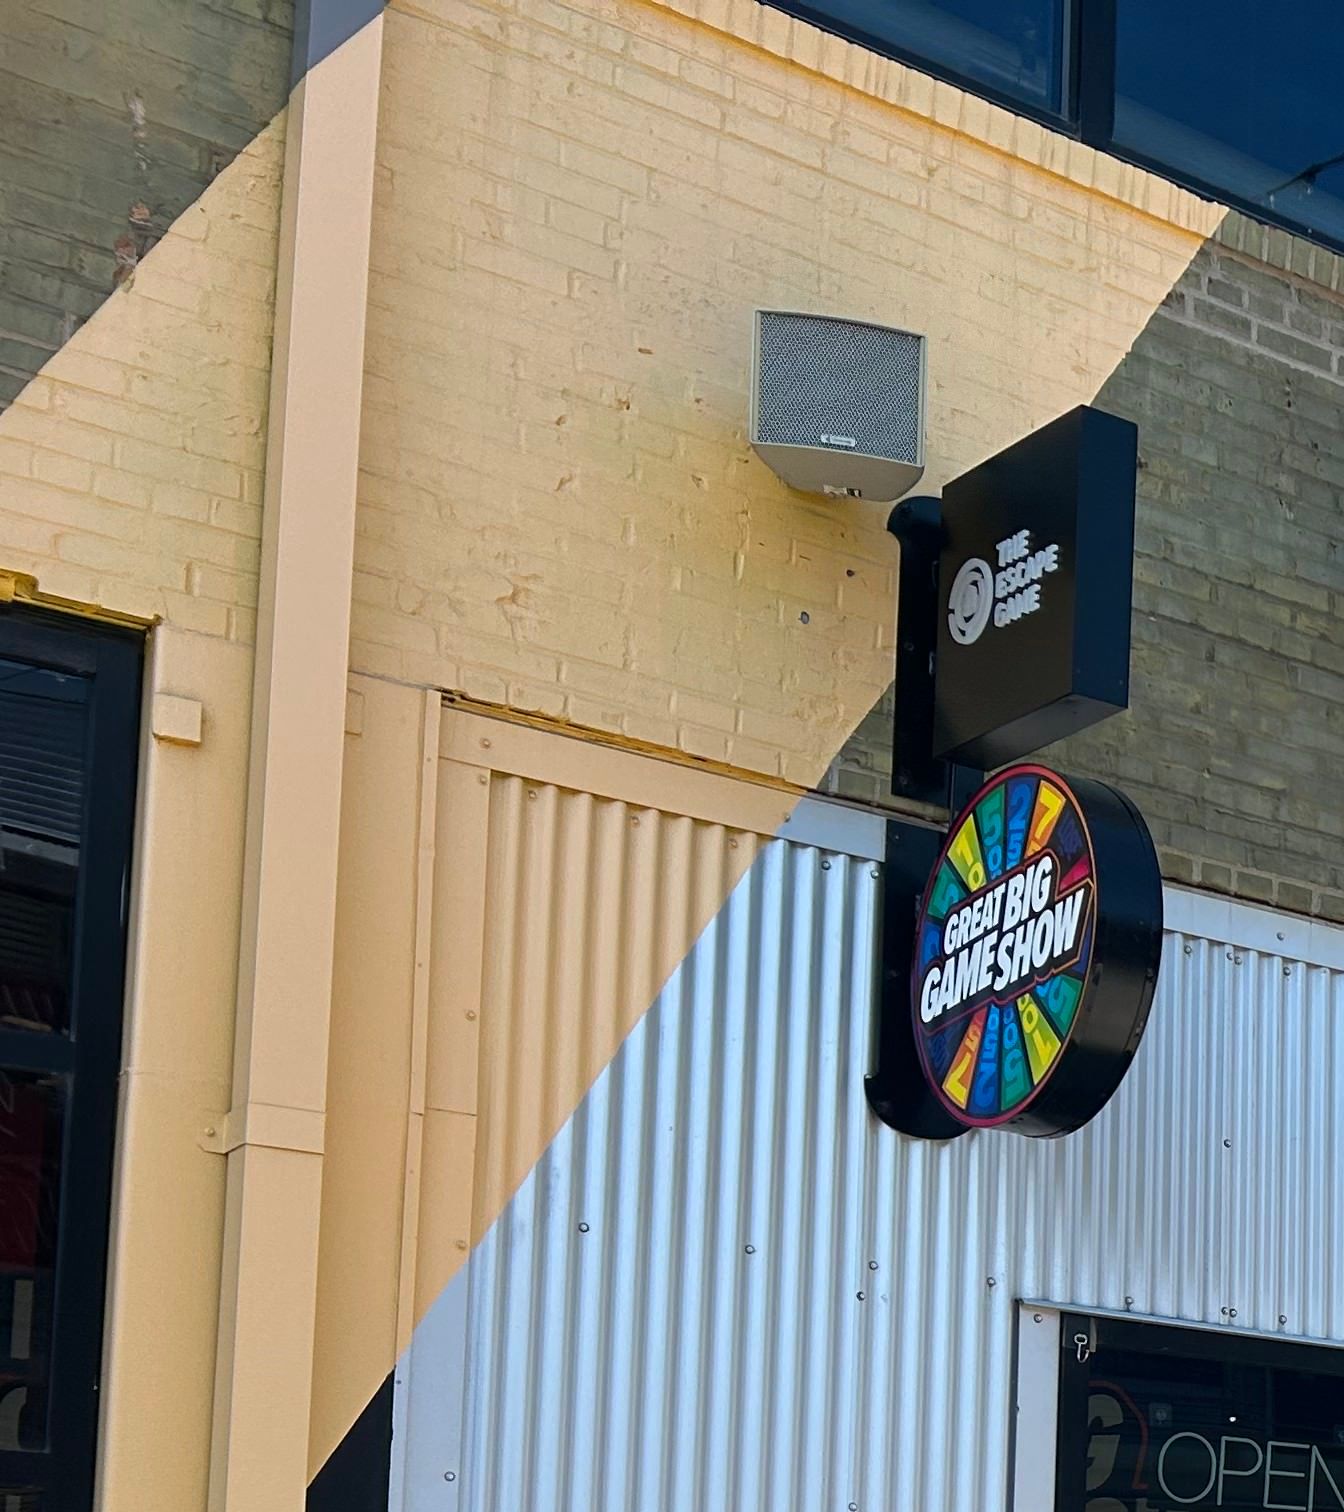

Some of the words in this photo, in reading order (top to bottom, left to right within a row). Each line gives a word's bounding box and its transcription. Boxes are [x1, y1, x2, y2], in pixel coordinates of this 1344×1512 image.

[995, 544, 1059, 598] ESCAPE
[944, 883, 1006, 954] GREAT
[1003, 855, 1053, 933] BIG
[920, 930, 999, 1024] GAME
[993, 888, 1085, 991] SHOW
